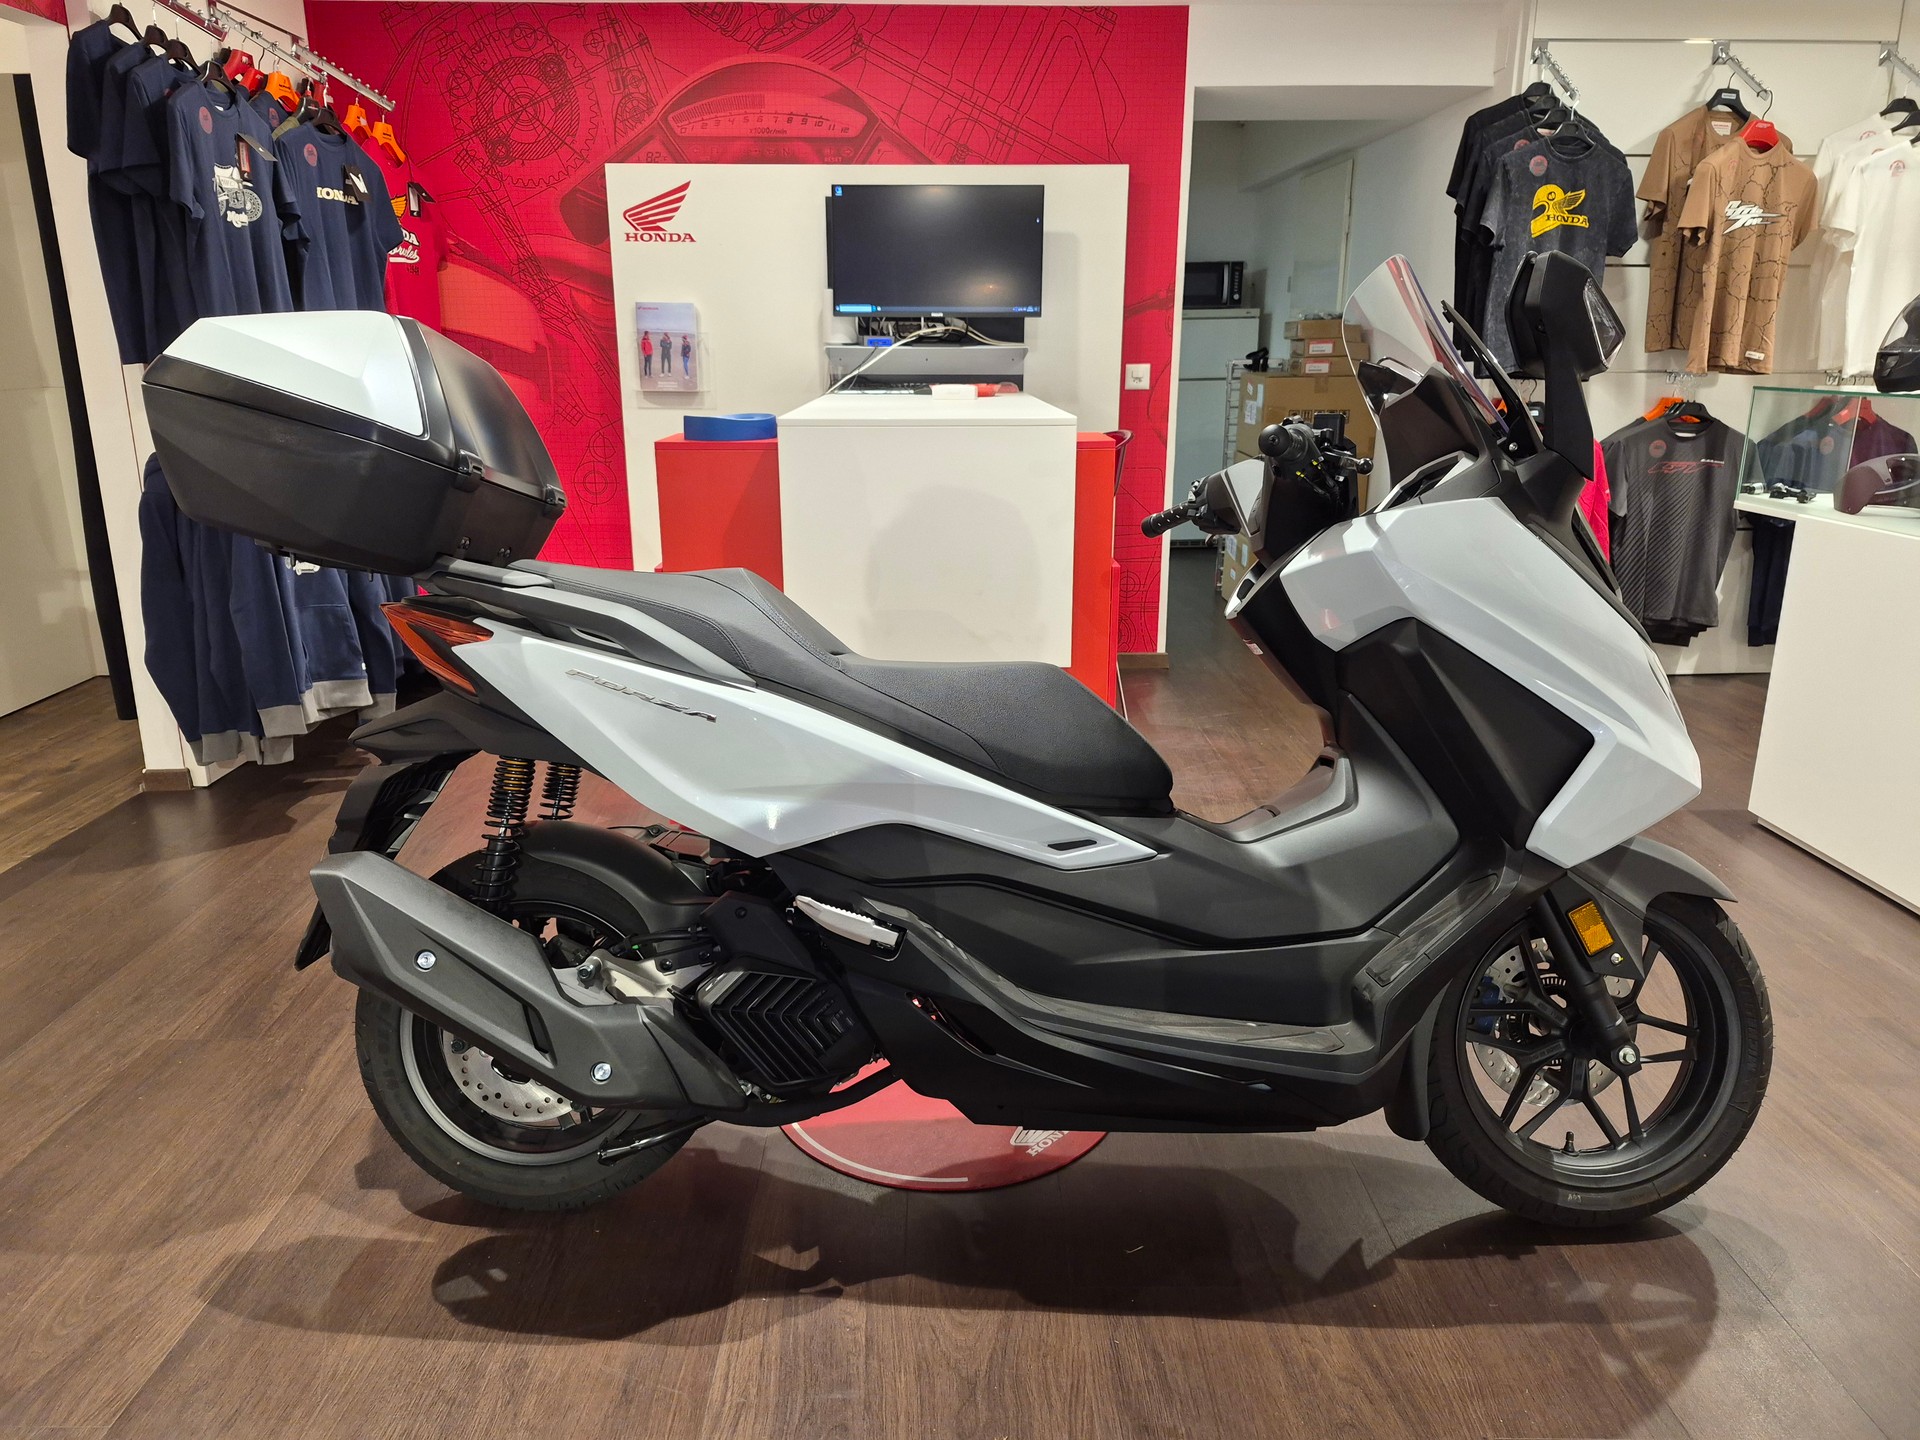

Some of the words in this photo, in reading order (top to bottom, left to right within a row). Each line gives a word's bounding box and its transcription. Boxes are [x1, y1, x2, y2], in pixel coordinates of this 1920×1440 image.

[1545, 214, 1588, 226] HONDA
[624, 232, 696, 243] HONDA
[565, 668, 717, 723] FORZA
[1026, 1131, 1070, 1157] HON
